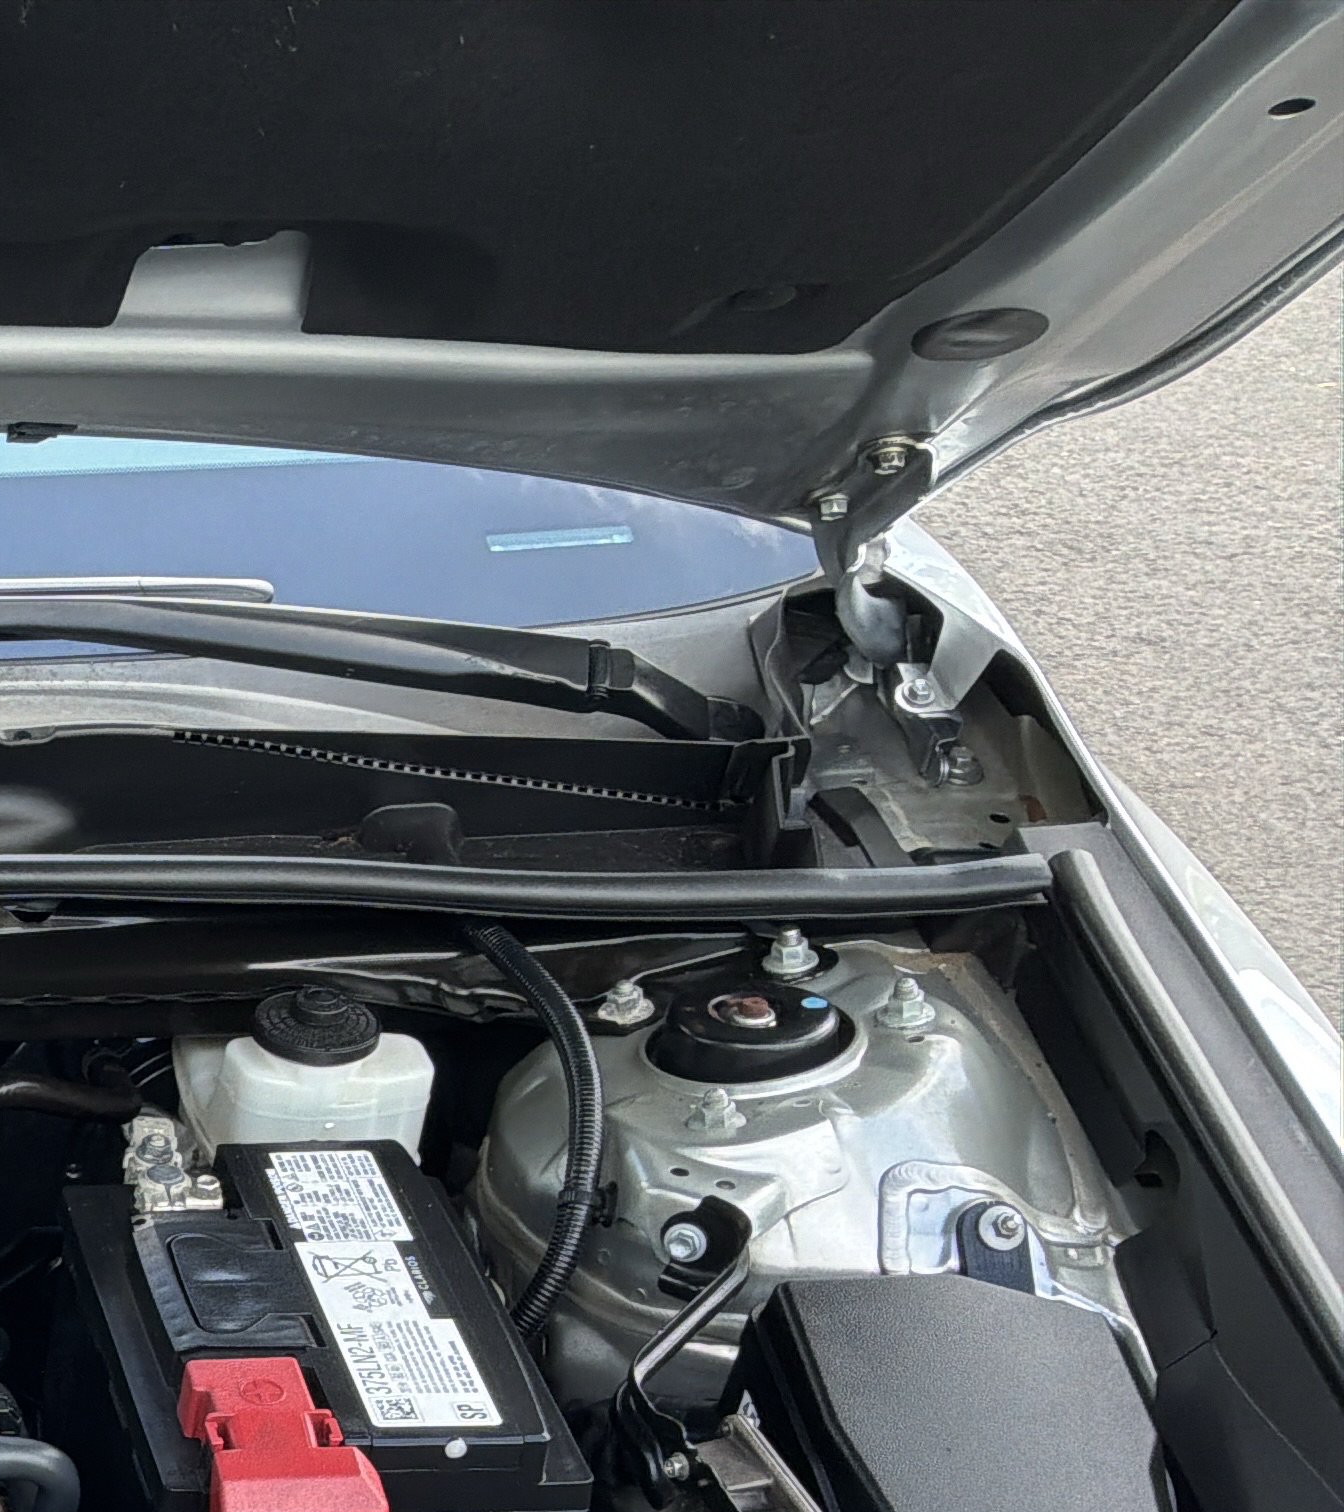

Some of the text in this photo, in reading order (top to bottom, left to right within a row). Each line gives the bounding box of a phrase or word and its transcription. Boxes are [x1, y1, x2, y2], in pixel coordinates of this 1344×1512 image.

[405, 1255, 430, 1293] CLARIOS
[336, 1322, 392, 1396] 375LN2-MF
[459, 1401, 488, 1421] SP
